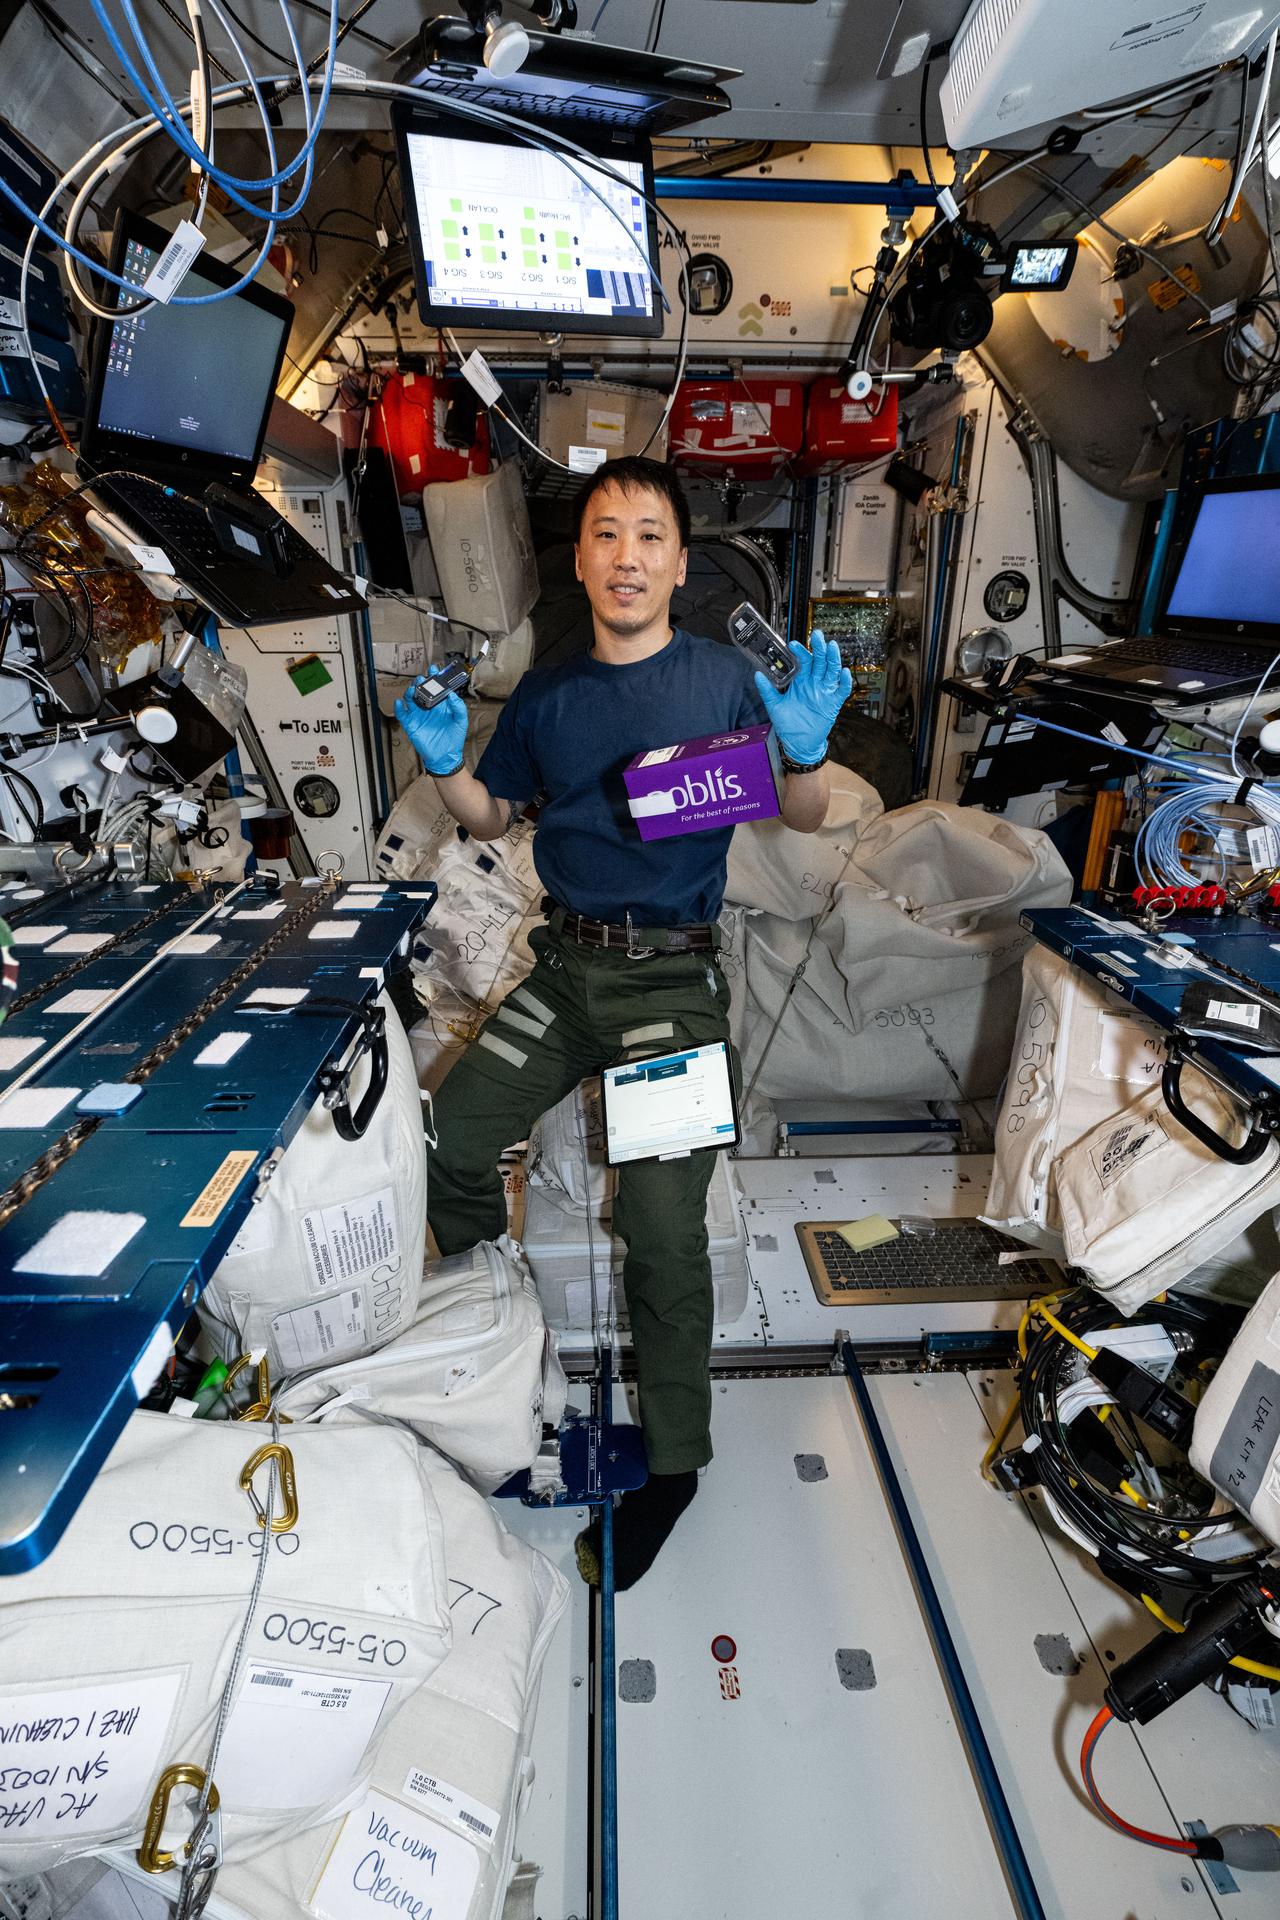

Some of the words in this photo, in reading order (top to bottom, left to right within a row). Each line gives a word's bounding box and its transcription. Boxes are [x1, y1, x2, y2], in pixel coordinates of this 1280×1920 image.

[451, 267, 467, 278] S/G
[487, 269, 503, 280] S/G
[529, 273, 543, 283] S/G
[562, 275, 576, 285] S/G
[862, 494, 880, 502] Zenith
[459, 538, 478, 593] 10-5690
[292, 720, 309, 734] To
[312, 719, 341, 734] JEM
[648, 765, 743, 810] oblis
[681, 814, 693, 823] For
[693, 811, 705, 820] the
[706, 809, 722, 818] best
[723, 806, 731, 816] of
[732, 801, 761, 812] reasons
[875, 1006, 935, 1028] 5093
[1007, 995, 1047, 1133] 10-5098
[304, 1216, 315, 1242] CLEANER
[310, 1240, 320, 1263] VACUUM
[320, 1242, 332, 1275] ACCESSORIES
[316, 1261, 326, 1285] CORDLESS
[1255, 1396, 1272, 1432] LEAK
[1243, 1439, 1260, 1465] KIT
[285, 1472, 294, 1498] CAMP
[129, 1521, 299, 1557] 0.5-5500
[263, 1613, 407, 1666] 0.5-5500
[320, 1699, 335, 1707] CTB
[66, 1751, 110, 1785] S/N
[414, 1772, 423, 1782] 1.0
[423, 1777, 437, 1788] CTB
[417, 1786, 428, 1796] 5277
[56, 1793, 98, 1821] AC
[368, 1811, 438, 1876] Vacuum
